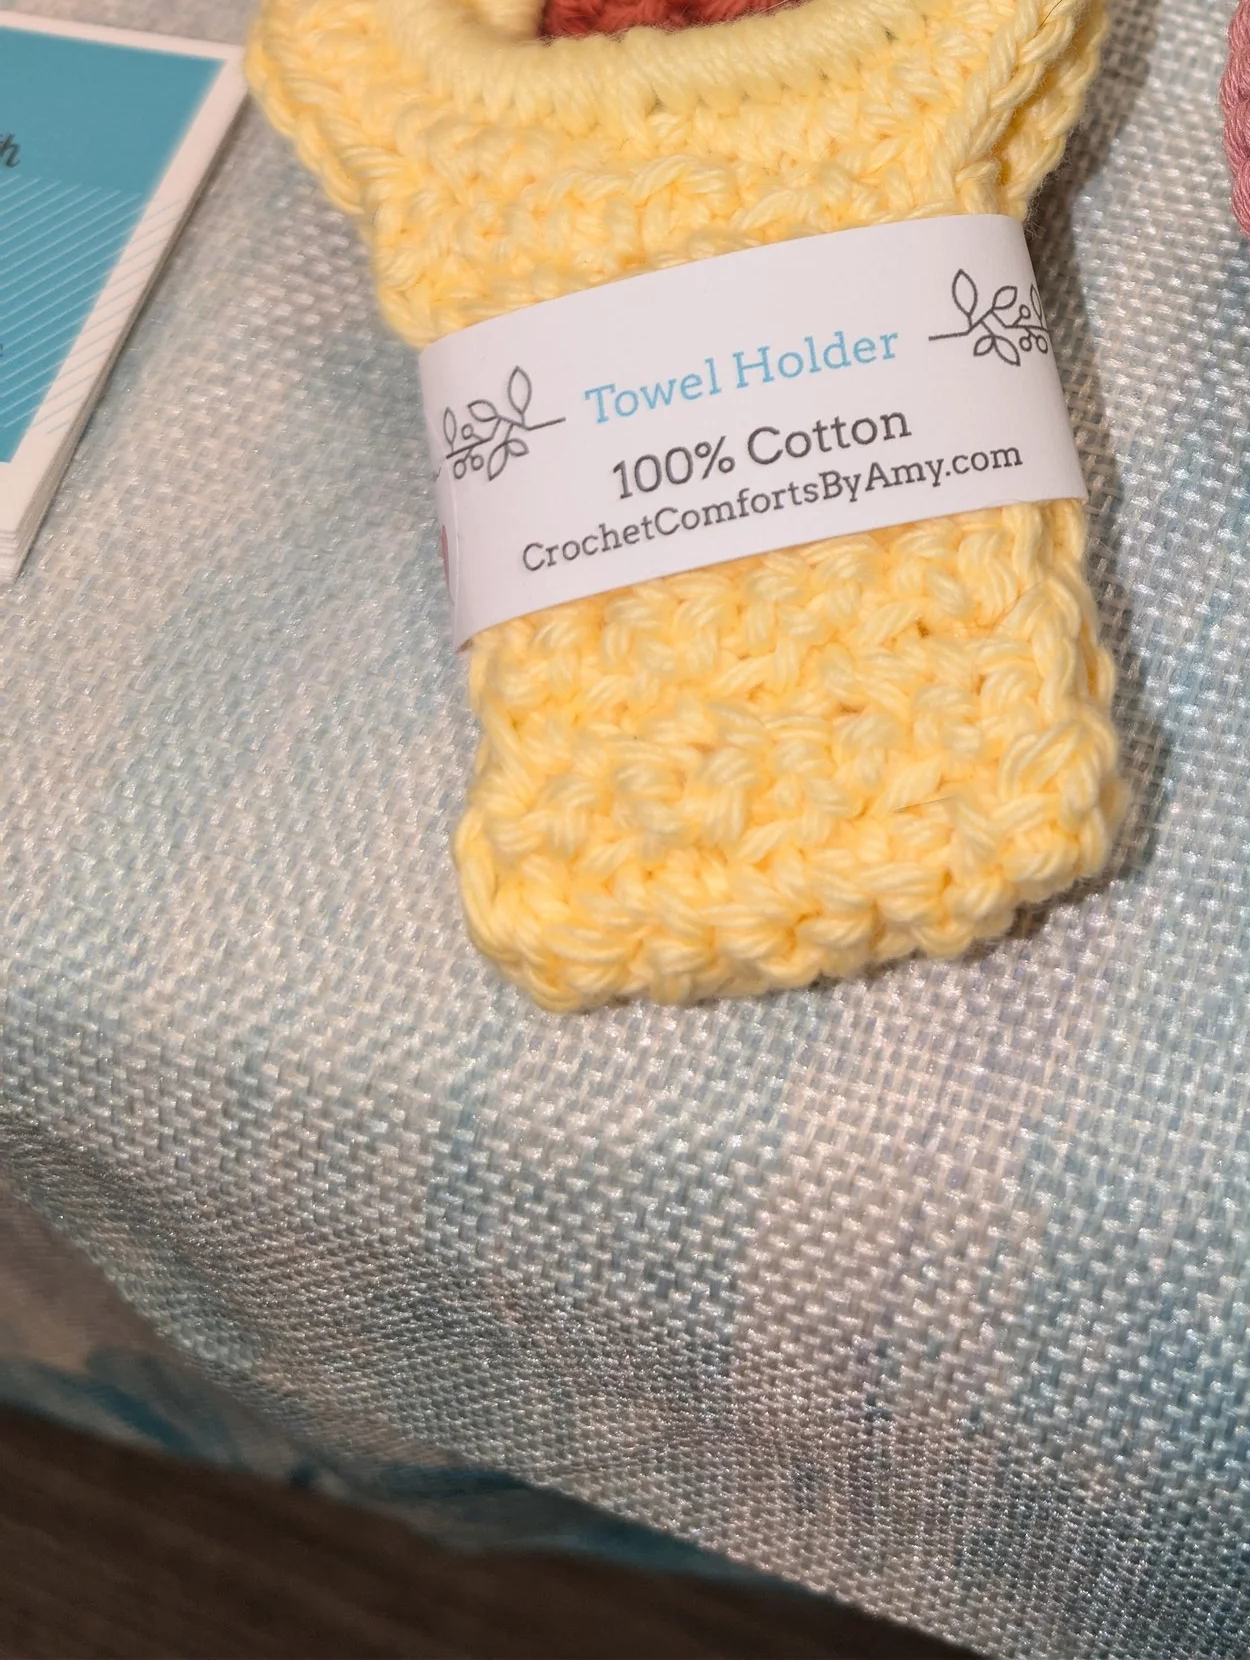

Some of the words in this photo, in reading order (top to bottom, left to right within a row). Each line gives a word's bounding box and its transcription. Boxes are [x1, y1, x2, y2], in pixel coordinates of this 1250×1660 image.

[585, 358, 721, 425] Towel
[733, 331, 898, 390] Holder
[613, 435, 735, 500] 100%
[747, 411, 911, 466] Cotton
[522, 443, 1023, 572] CrochetComfortsByAmy.com
